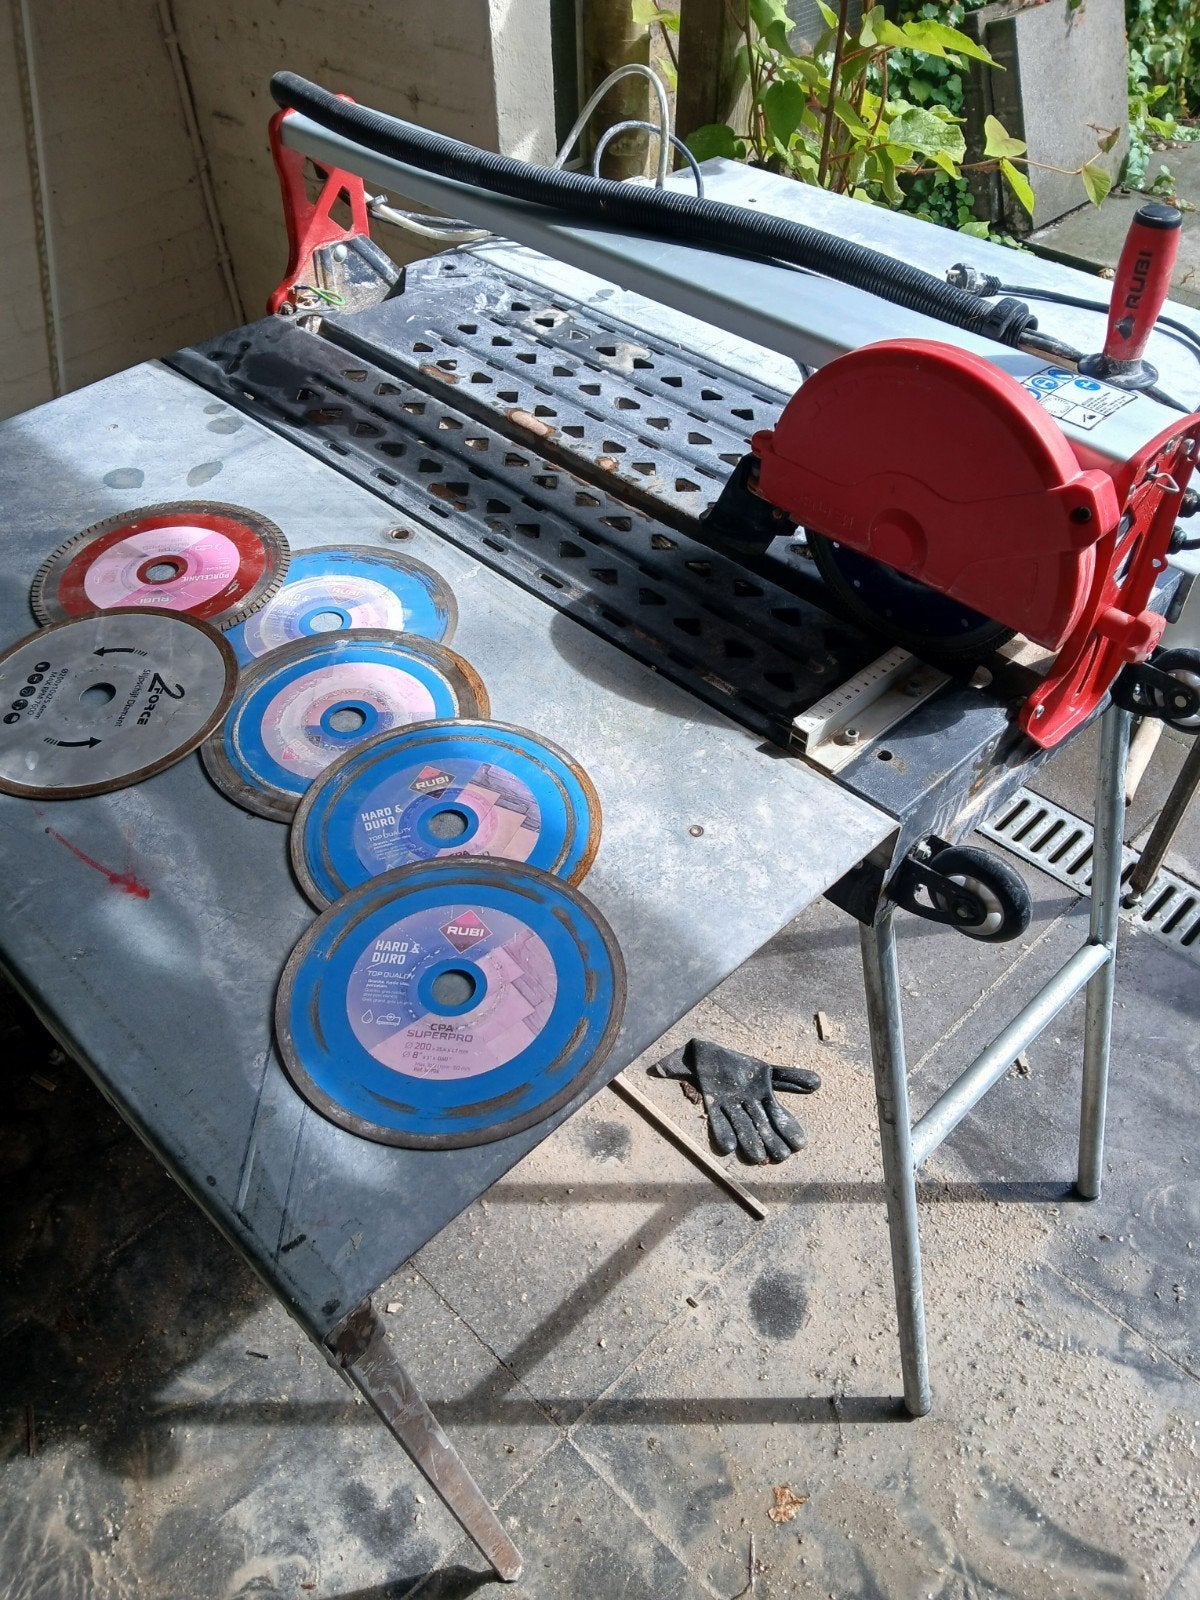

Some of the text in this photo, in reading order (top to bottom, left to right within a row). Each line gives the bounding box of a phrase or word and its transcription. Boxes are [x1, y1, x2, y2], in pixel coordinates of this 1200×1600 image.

[1124, 250, 1152, 310] RUBI
[332, 587, 360, 596] RUBI
[139, 596, 170, 604] RUBI
[416, 775, 450, 790] RUBI
[361, 804, 404, 821] HARD &
[364, 816, 396, 832] DURO
[446, 926, 485, 937] RUBI
[375, 940, 420, 953] HARD &
[372, 952, 406, 965] DURO
[430, 1023, 454, 1032] CPA
[406, 1030, 474, 1042] SUPERPRO
[414, 1042, 432, 1050] 200
